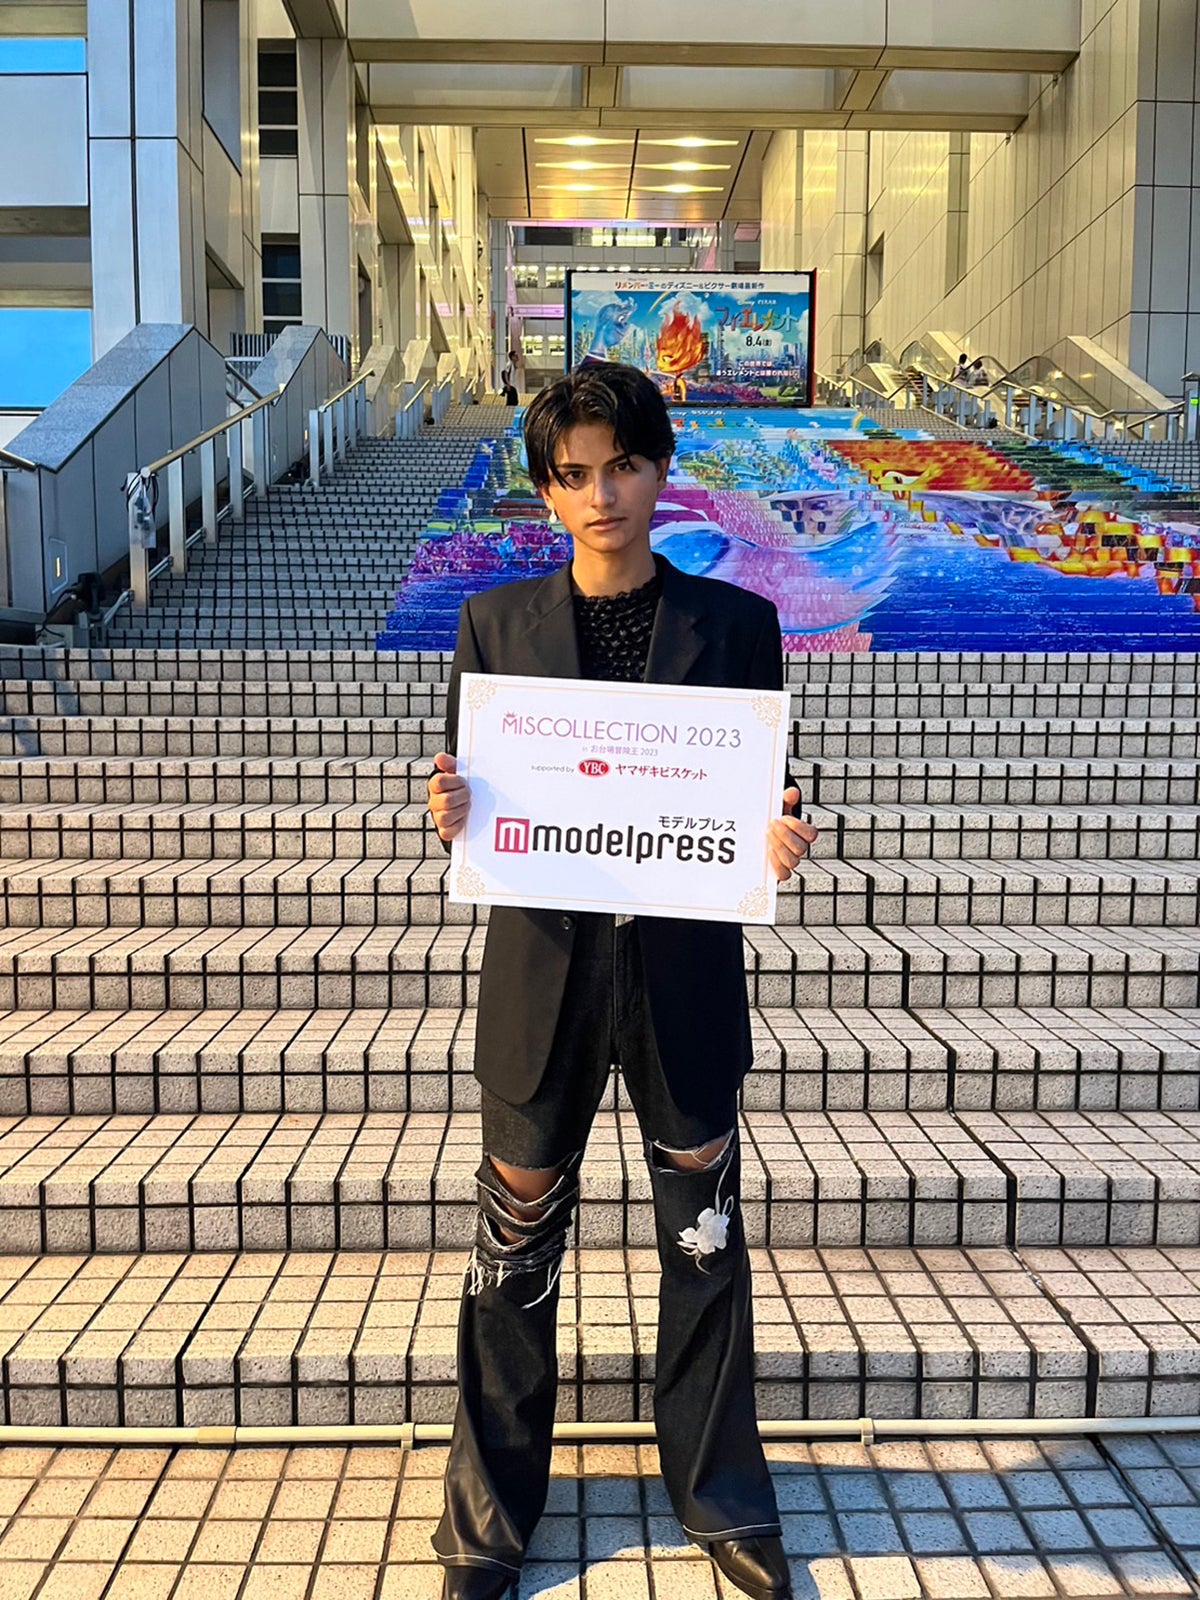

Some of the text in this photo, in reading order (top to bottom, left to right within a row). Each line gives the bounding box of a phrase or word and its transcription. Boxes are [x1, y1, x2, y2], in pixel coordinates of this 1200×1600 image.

[502, 714, 742, 748] MISCOLLECTION 2023
[640, 747, 658, 757] 2023
[531, 761, 607, 776] supported by YBC
[615, 763, 708, 781] ヤマザキビスケット
[658, 815, 736, 832] モデルプレス
[532, 823, 736, 864] modelpress
